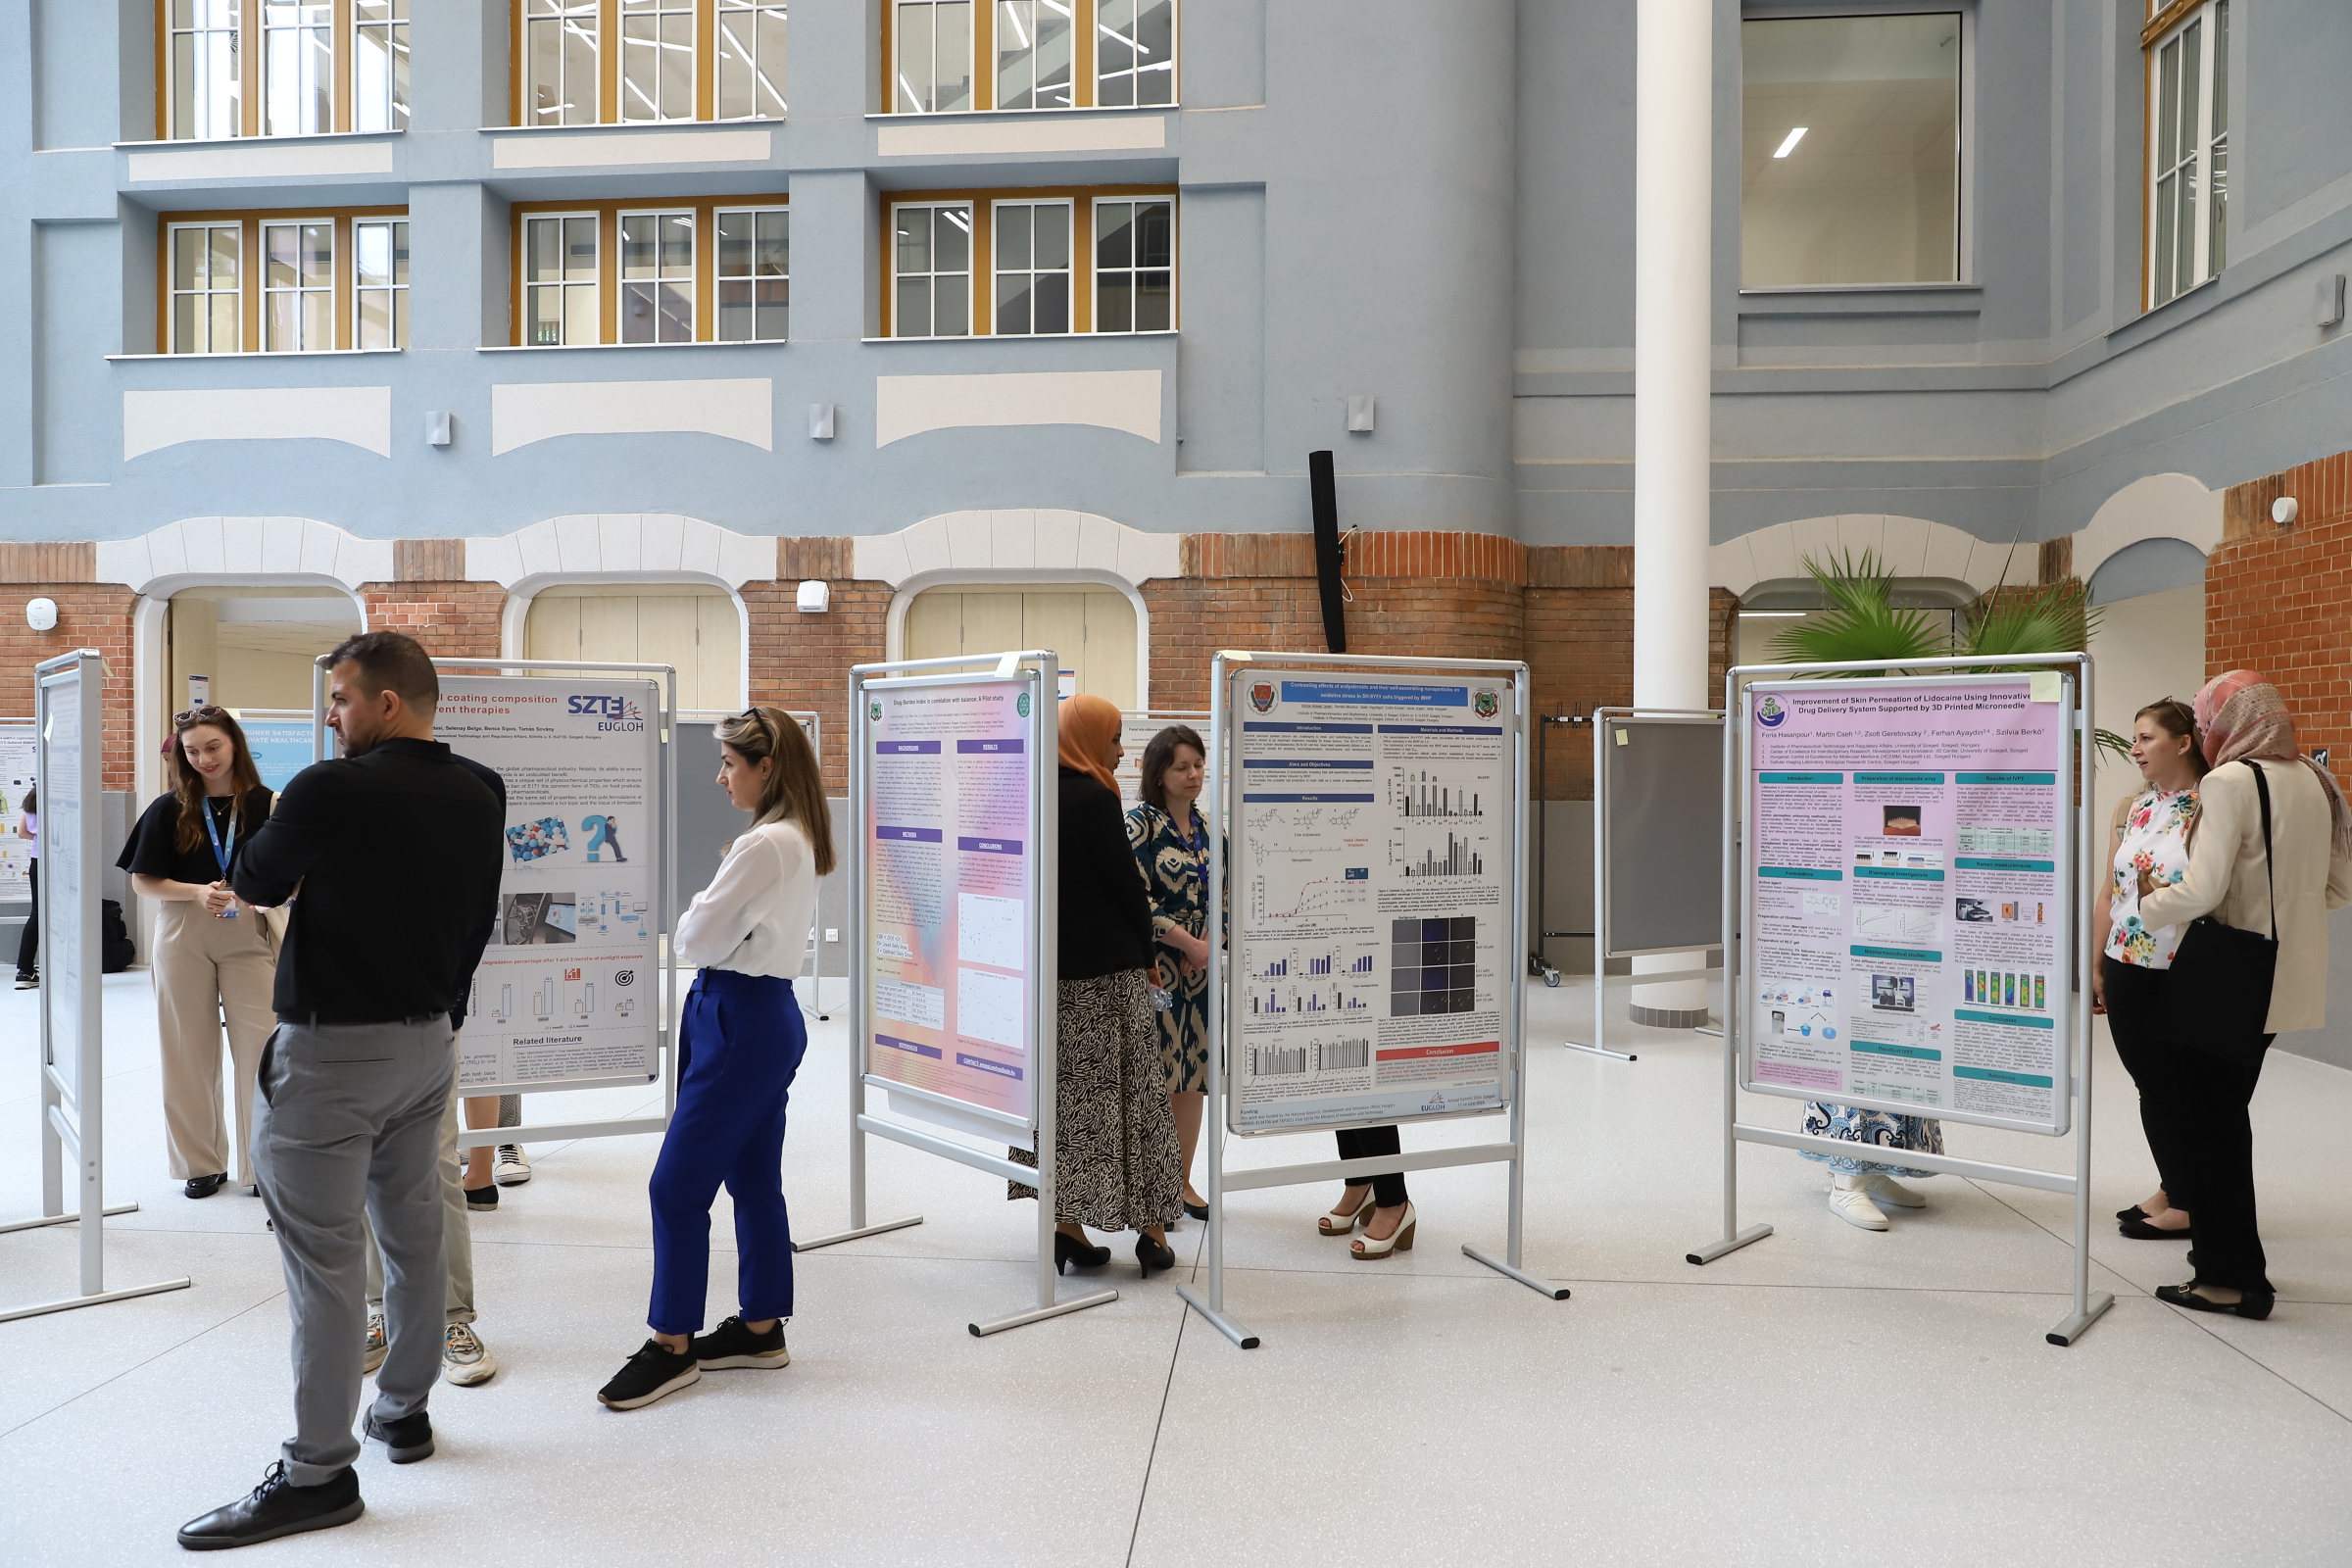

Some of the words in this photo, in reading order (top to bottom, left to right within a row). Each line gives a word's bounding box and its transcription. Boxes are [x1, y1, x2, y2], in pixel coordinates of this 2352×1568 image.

[447, 694, 488, 704] coating
[491, 694, 558, 704] composition
[460, 706, 510, 715] therapies
[1878, 705, 1918, 713] Supported
[598, 722, 644, 731] EUGLOH
[1988, 1073, 2016, 1081] References
